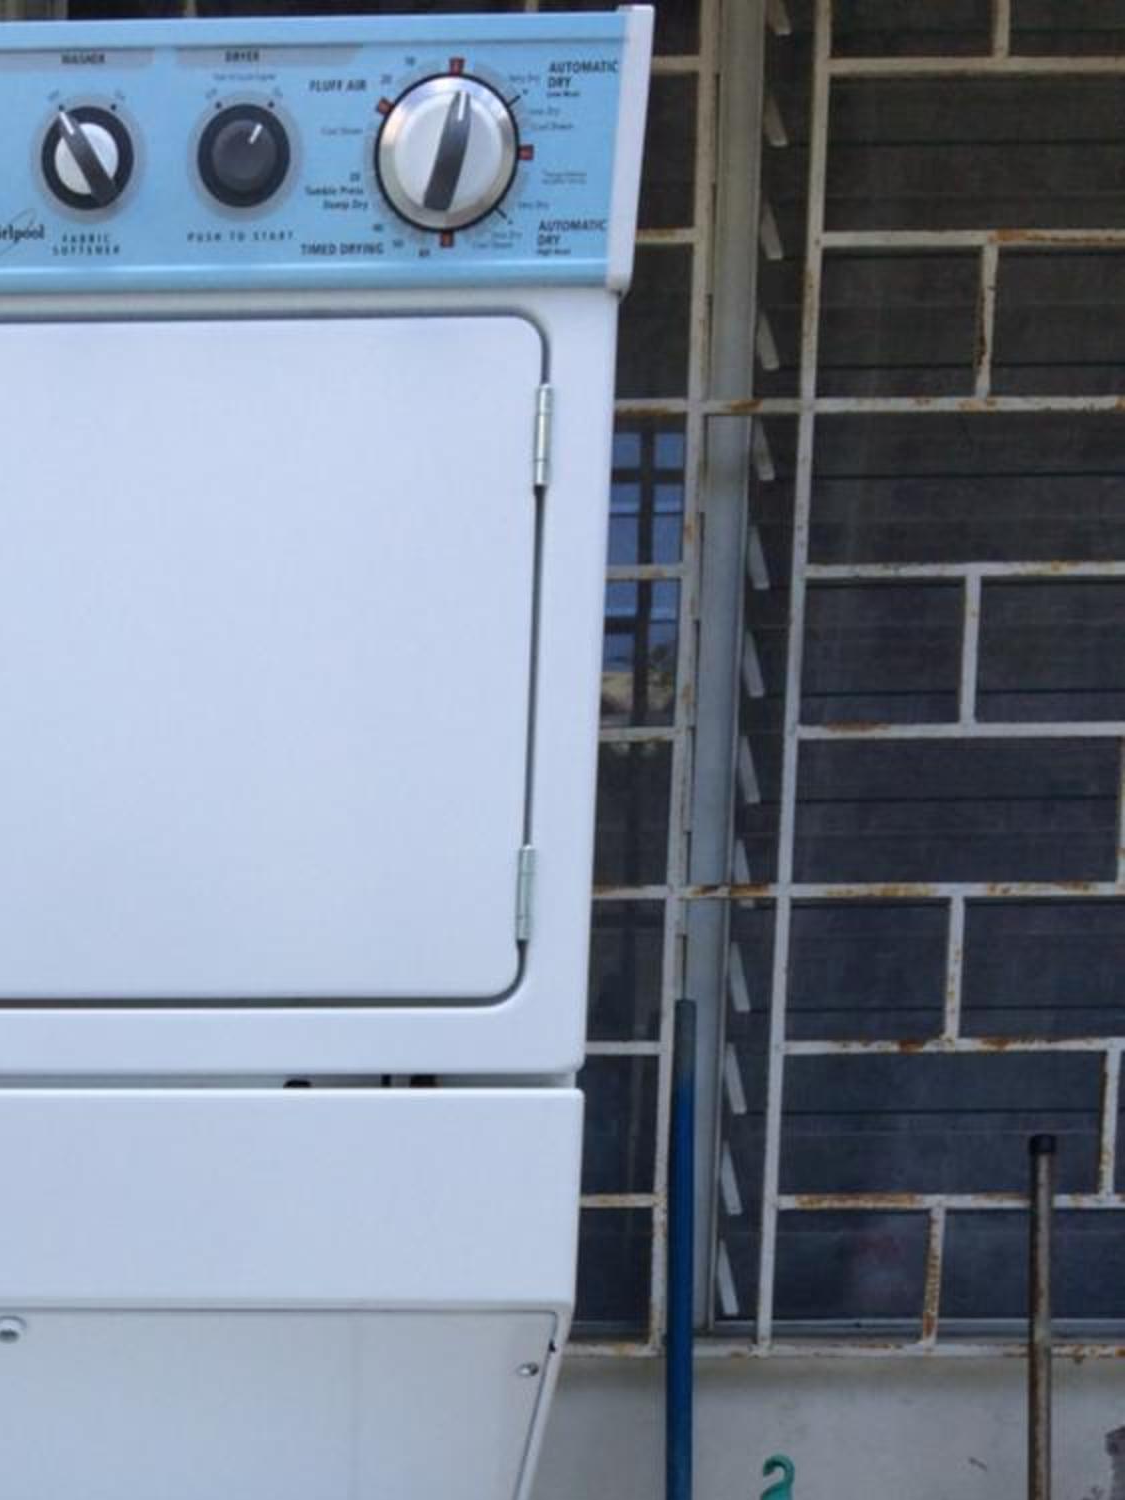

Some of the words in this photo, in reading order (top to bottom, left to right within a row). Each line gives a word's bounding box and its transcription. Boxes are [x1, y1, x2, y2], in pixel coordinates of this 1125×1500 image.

[548, 60, 619, 73] AUTOMATIC
[309, 80, 343, 92] FLUFF
[346, 80, 367, 91] AIR
[547, 76, 572, 88] DRY
[538, 219, 608, 232] AUTOMATIC
[187, 231, 222, 243] PUSH
[229, 231, 245, 242] TO
[252, 230, 294, 241] START
[537, 234, 561, 246] DRY
[300, 243, 337, 255] TIMED
[340, 243, 384, 255] DRYING
